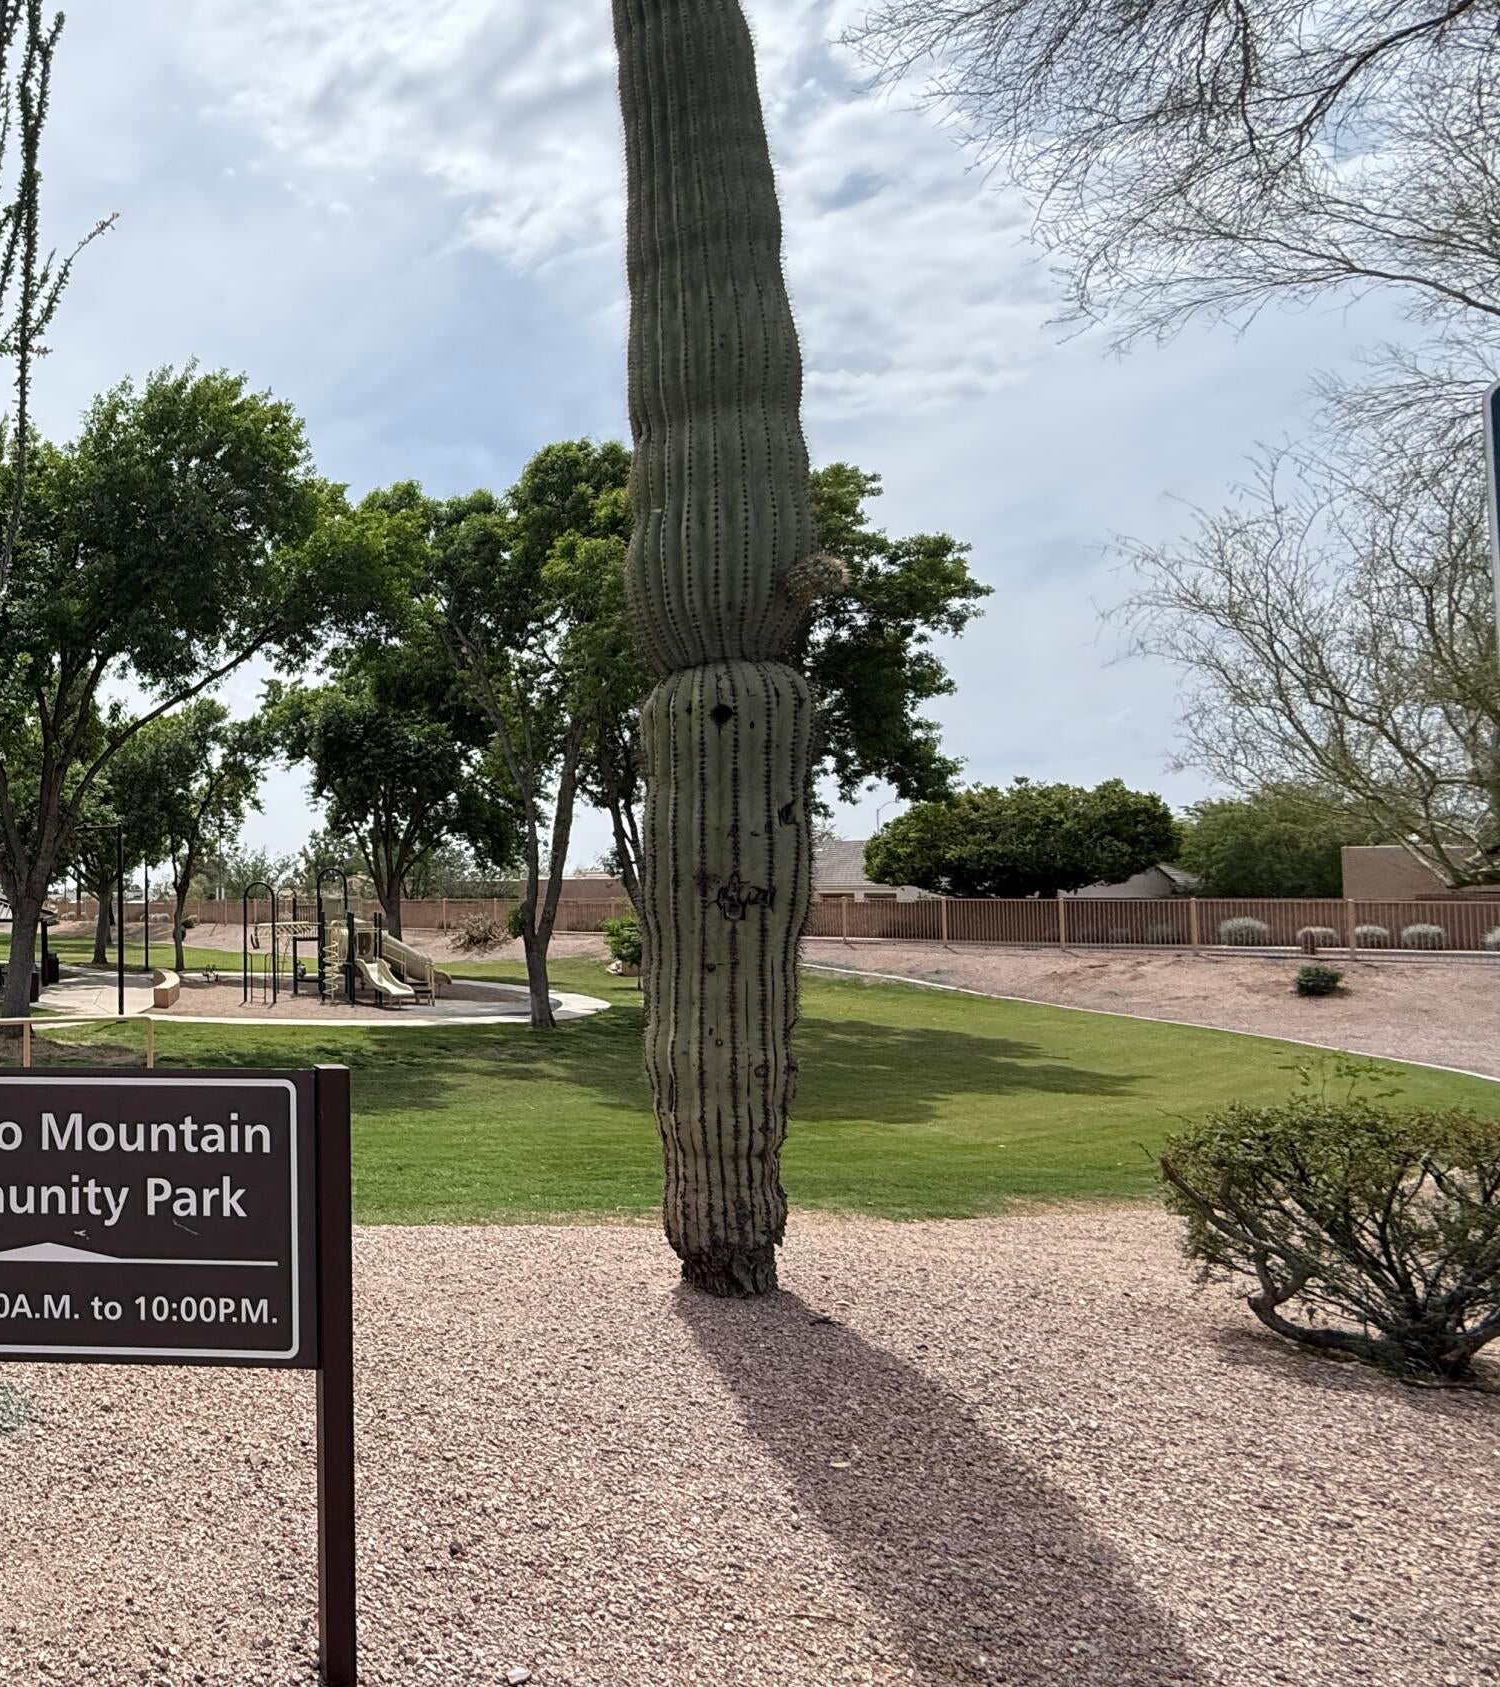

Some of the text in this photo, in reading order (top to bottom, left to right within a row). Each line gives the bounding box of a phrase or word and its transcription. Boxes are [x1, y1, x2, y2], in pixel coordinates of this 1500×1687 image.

[40, 1112, 271, 1154] Mountain
[145, 1175, 248, 1217] Park
[89, 1296, 122, 1321] to
[133, 1296, 278, 1324] 10:00P.M.
